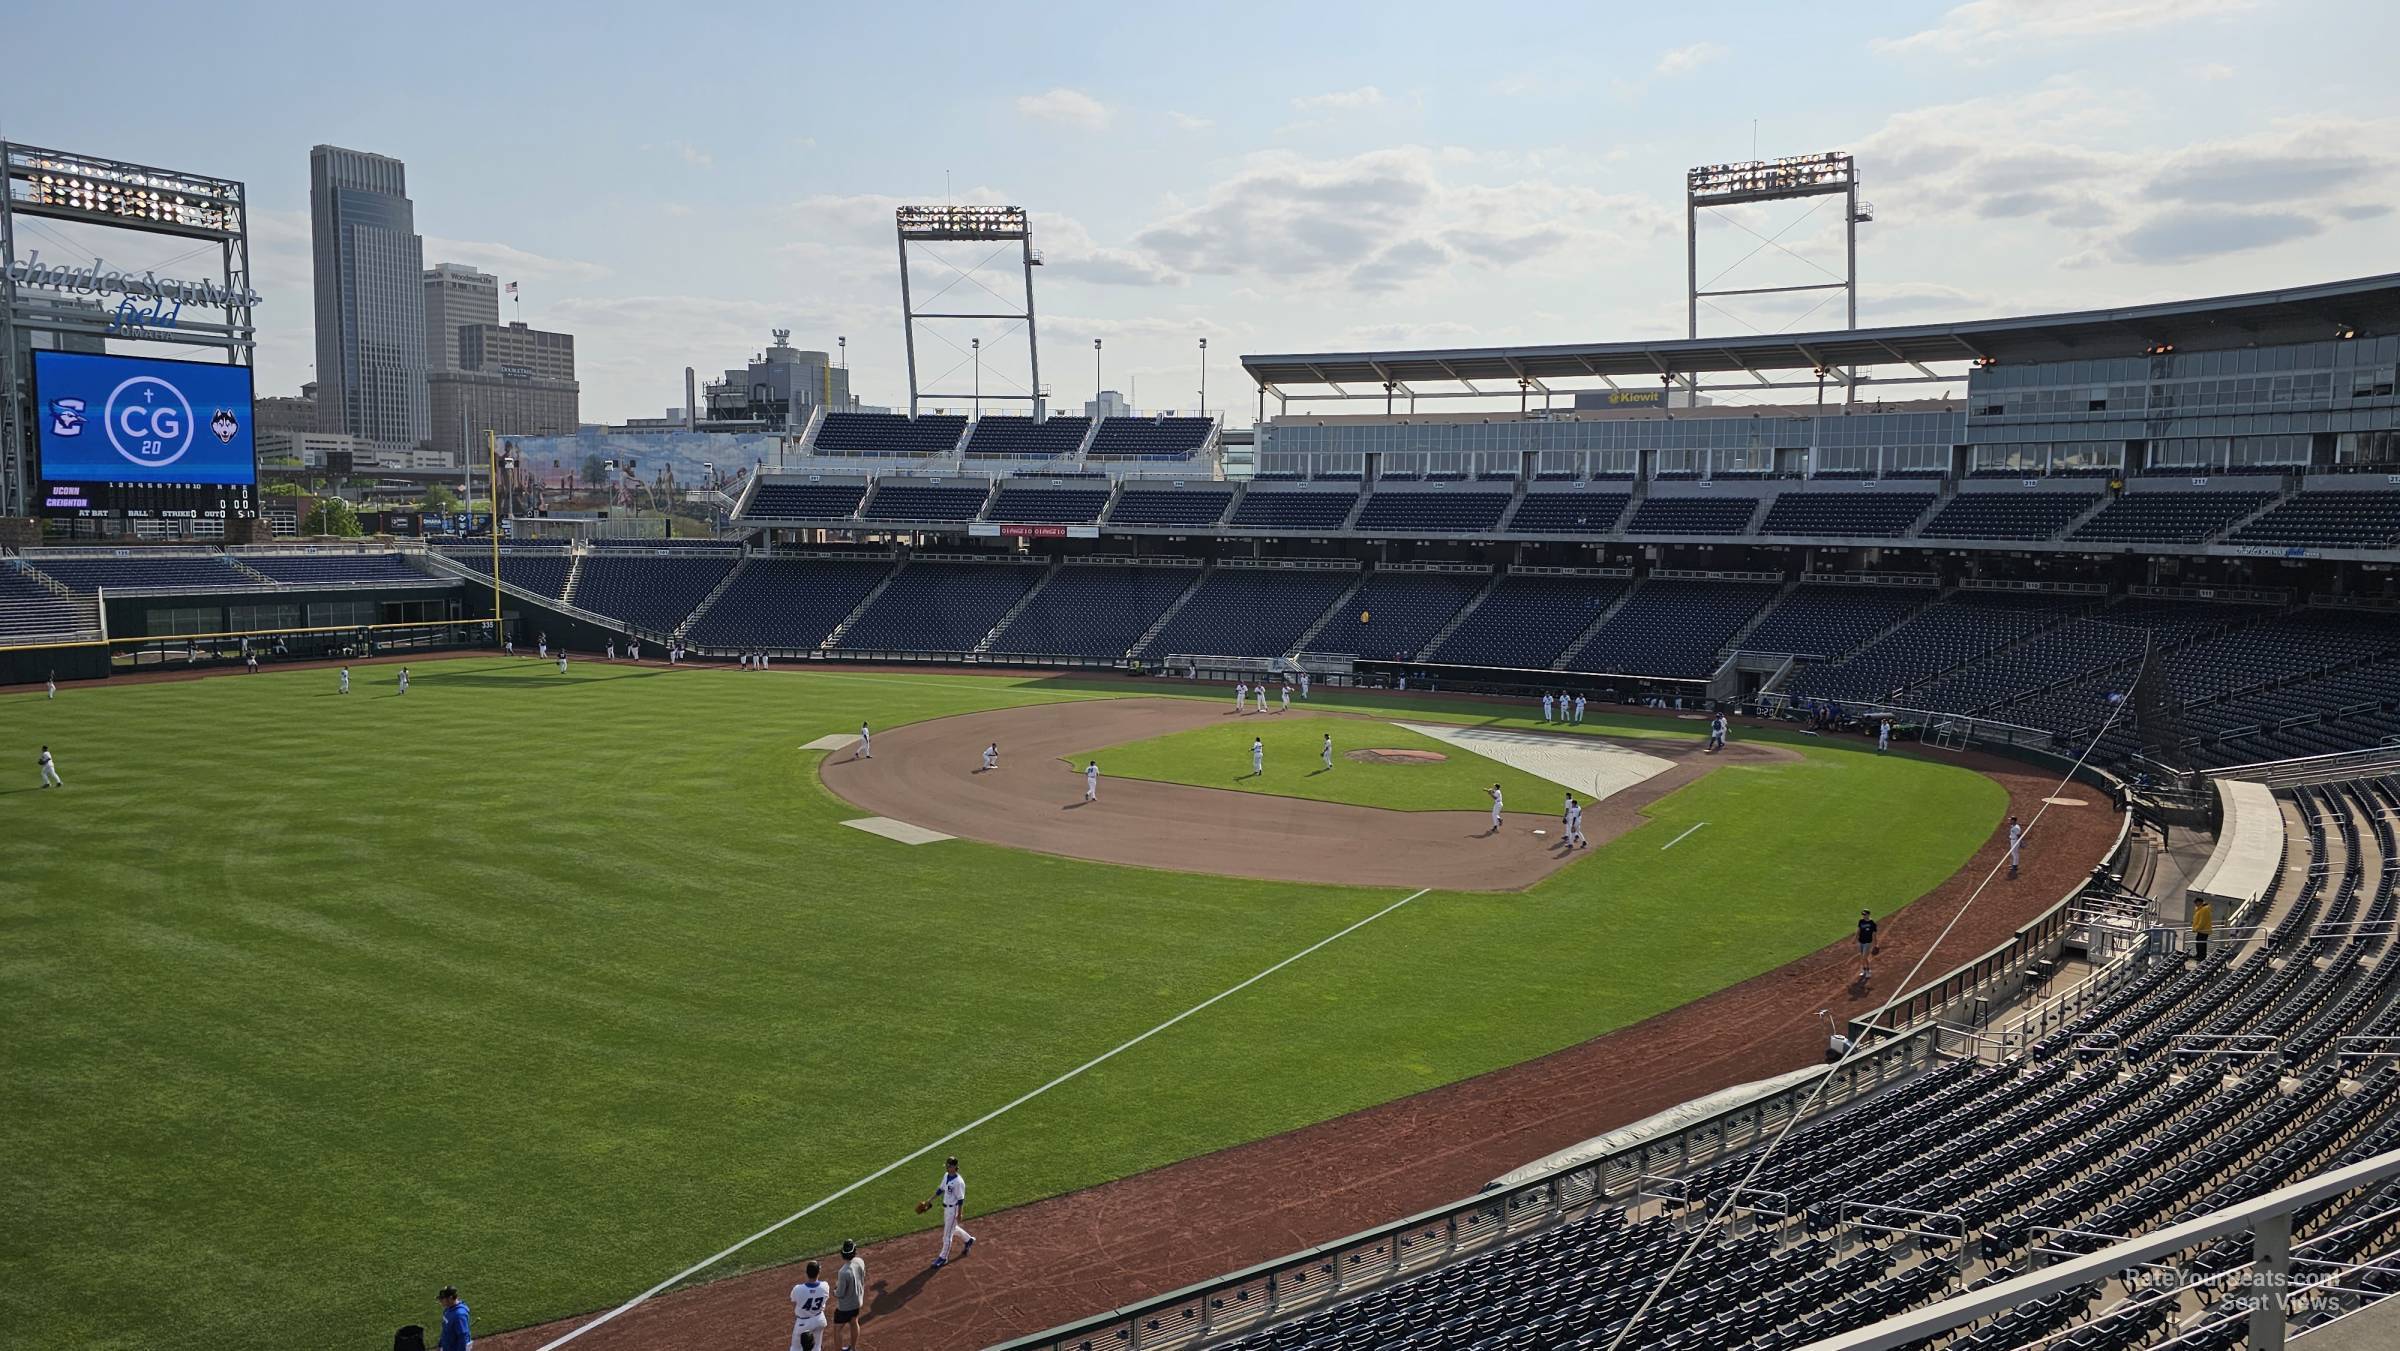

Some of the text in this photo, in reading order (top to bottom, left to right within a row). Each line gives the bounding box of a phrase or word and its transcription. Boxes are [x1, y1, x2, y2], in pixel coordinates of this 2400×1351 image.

[105, 298, 182, 333] field
[120, 325, 175, 341] OMAHA
[1620, 392, 1658, 402] Kiewit
[120, 405, 179, 439] CG
[141, 440, 162, 455] 20
[53, 486, 248, 499] UCONN 0
[46, 498, 248, 509] CREIGHTON 0 0 0
[191, 510, 196, 518] 0
[1756, 707, 1774, 716] 0:20
[802, 1297, 824, 1311] 43
